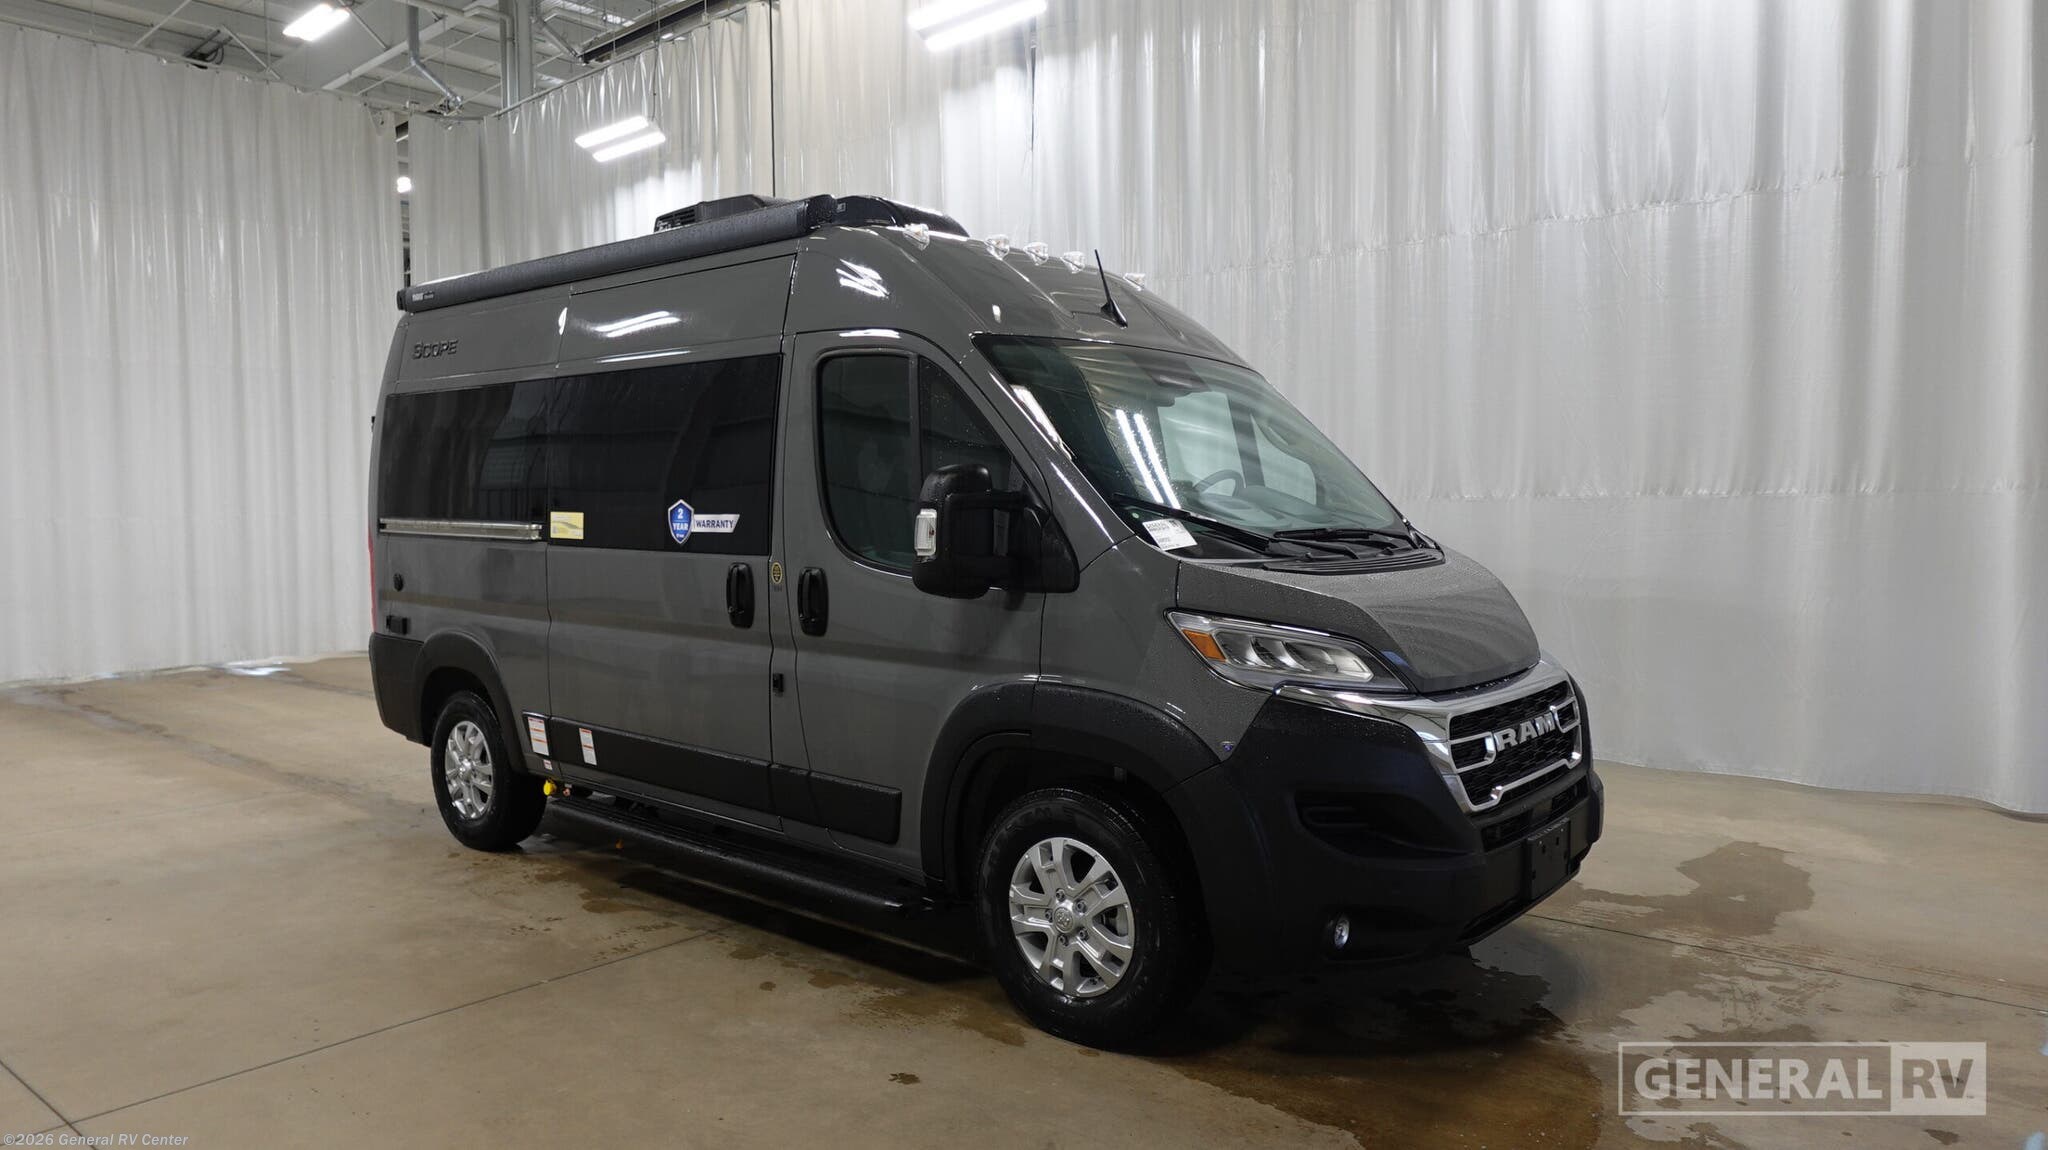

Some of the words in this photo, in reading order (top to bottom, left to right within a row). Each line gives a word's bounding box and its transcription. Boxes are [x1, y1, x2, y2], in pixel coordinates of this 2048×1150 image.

[413, 340, 458, 360] SCOPE
[677, 508, 684, 520] 2
[672, 522, 689, 531] YEAR
[695, 519, 734, 529] WARRANTY
[1494, 712, 1556, 752] RAM
